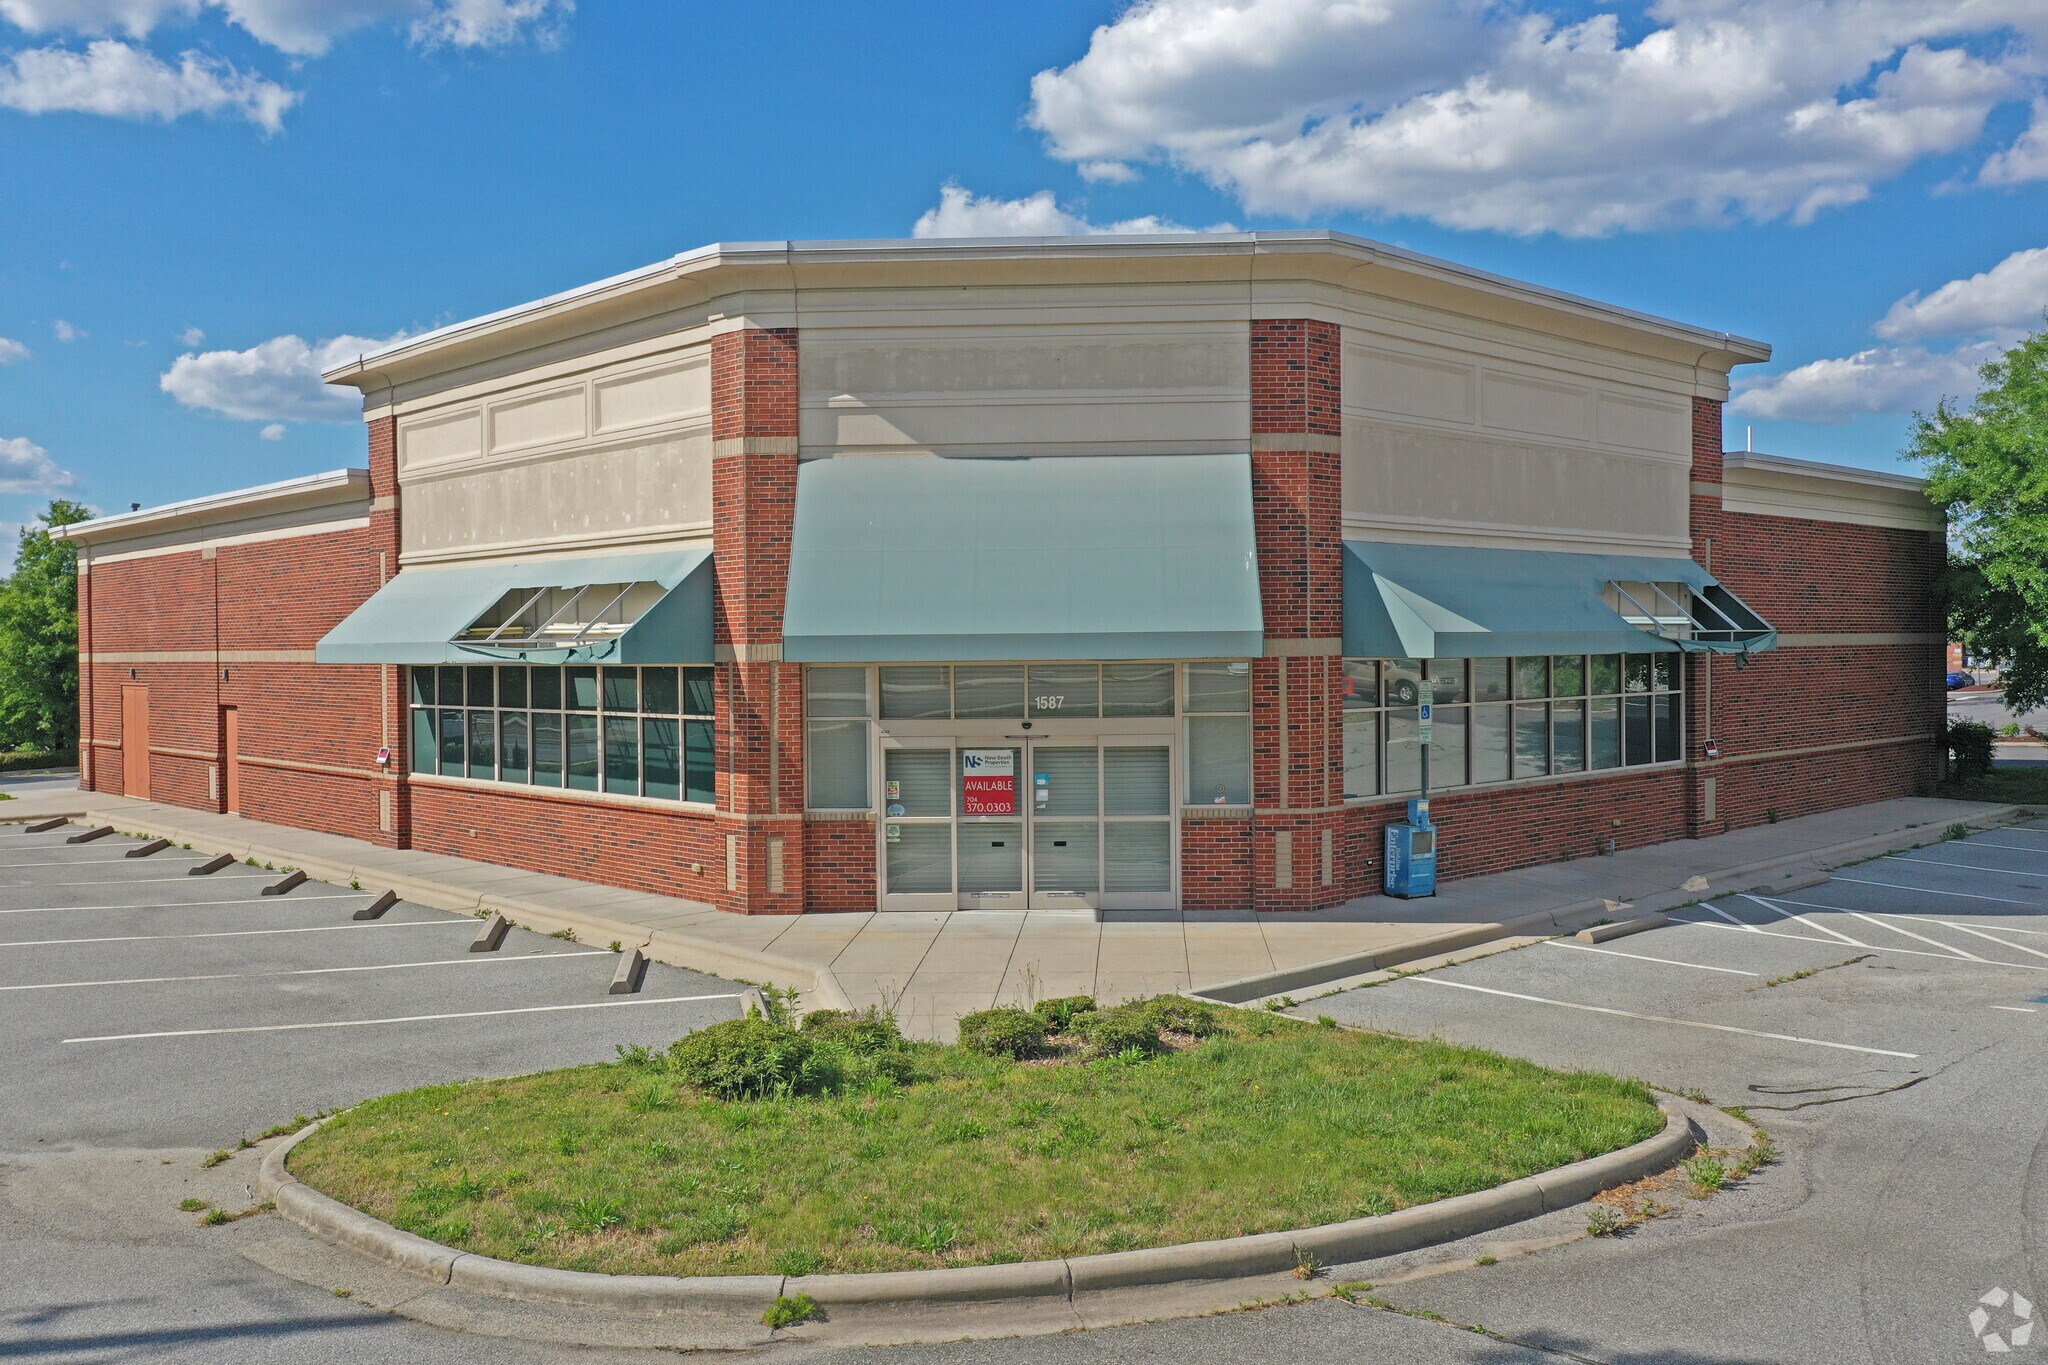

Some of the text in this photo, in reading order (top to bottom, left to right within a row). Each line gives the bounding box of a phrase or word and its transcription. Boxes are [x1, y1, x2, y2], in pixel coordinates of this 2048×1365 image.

[1034, 695, 1065, 710] 1587
[965, 755, 983, 768] NS
[964, 780, 1013, 791] AVAILABLE
[966, 802, 1011, 813] 370.0303
[1389, 829, 1400, 889] Enterprise
